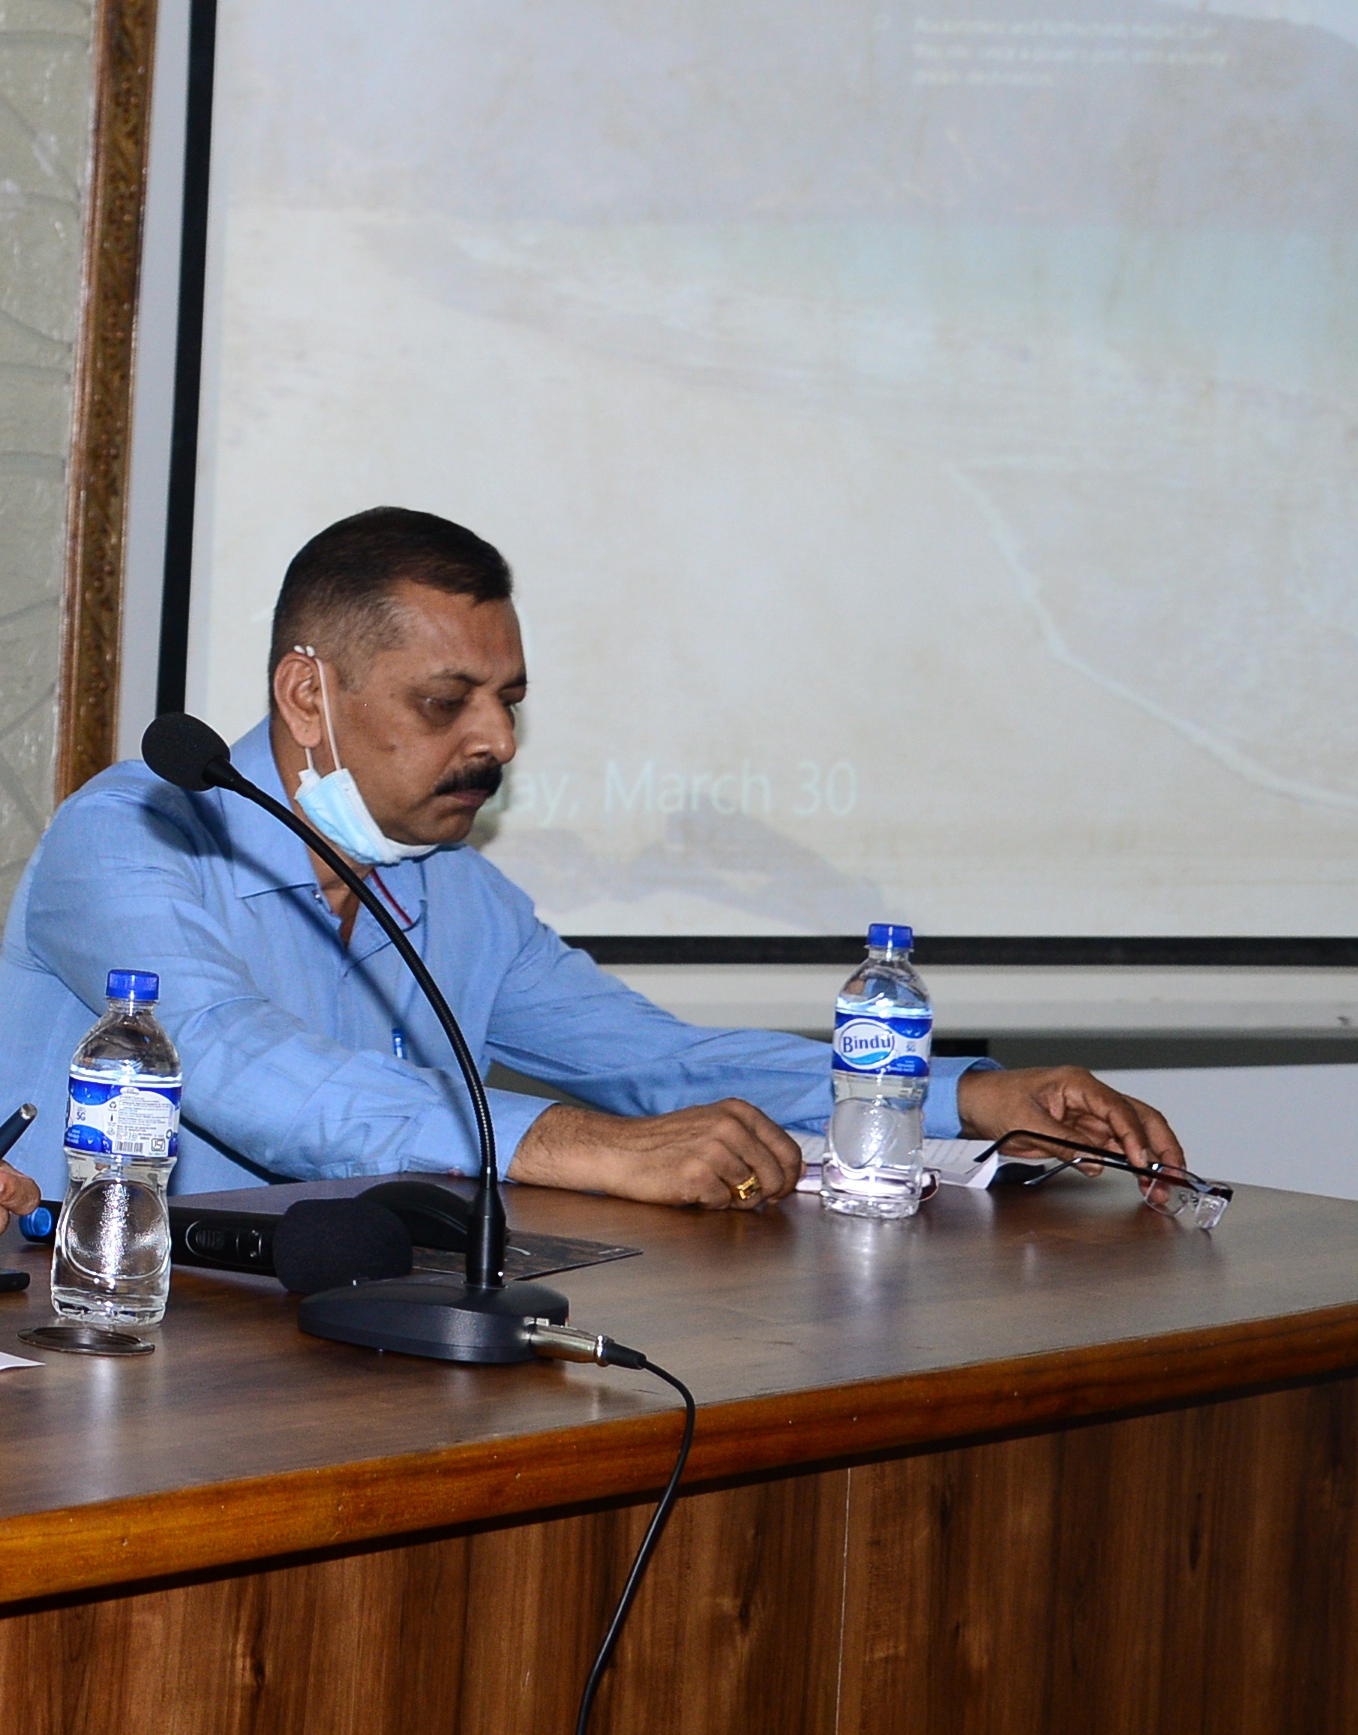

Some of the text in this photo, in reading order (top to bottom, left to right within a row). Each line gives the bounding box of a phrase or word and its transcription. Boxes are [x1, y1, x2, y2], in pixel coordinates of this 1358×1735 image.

[602, 759, 773, 816] March
[792, 761, 857, 816] 30
[843, 1035, 891, 1053] Bindu
